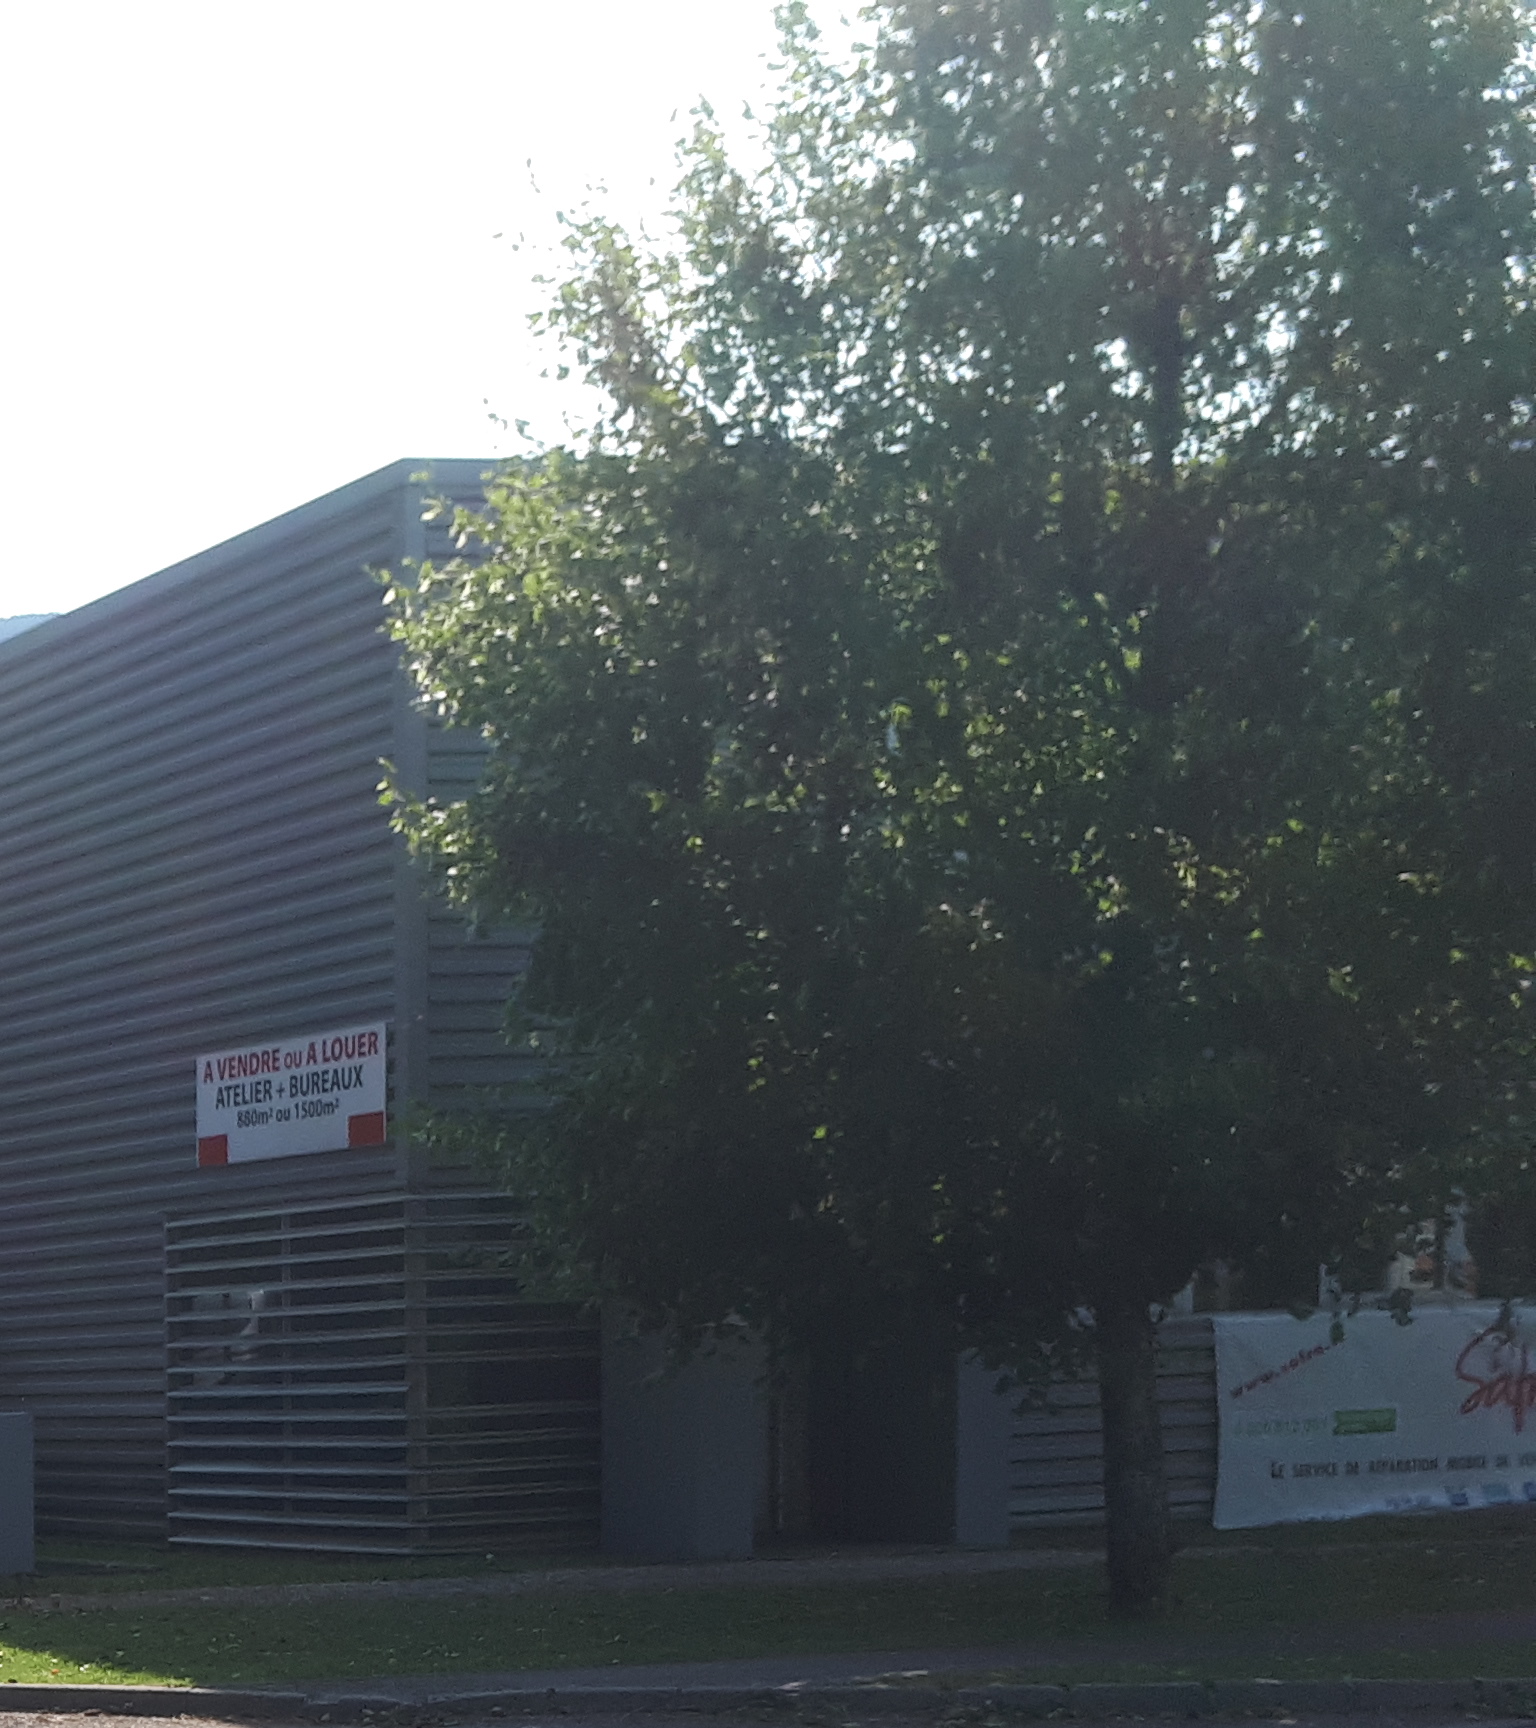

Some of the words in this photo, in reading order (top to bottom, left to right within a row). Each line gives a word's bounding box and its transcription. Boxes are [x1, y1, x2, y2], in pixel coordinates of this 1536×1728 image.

[203, 1060, 214, 1083] A
[216, 1049, 281, 1081] VENDRE
[306, 1041, 318, 1064] A
[322, 1031, 379, 1063] LOUER
[215, 1078, 273, 1110] ATELIER
[289, 1064, 364, 1099] BUREAUX
